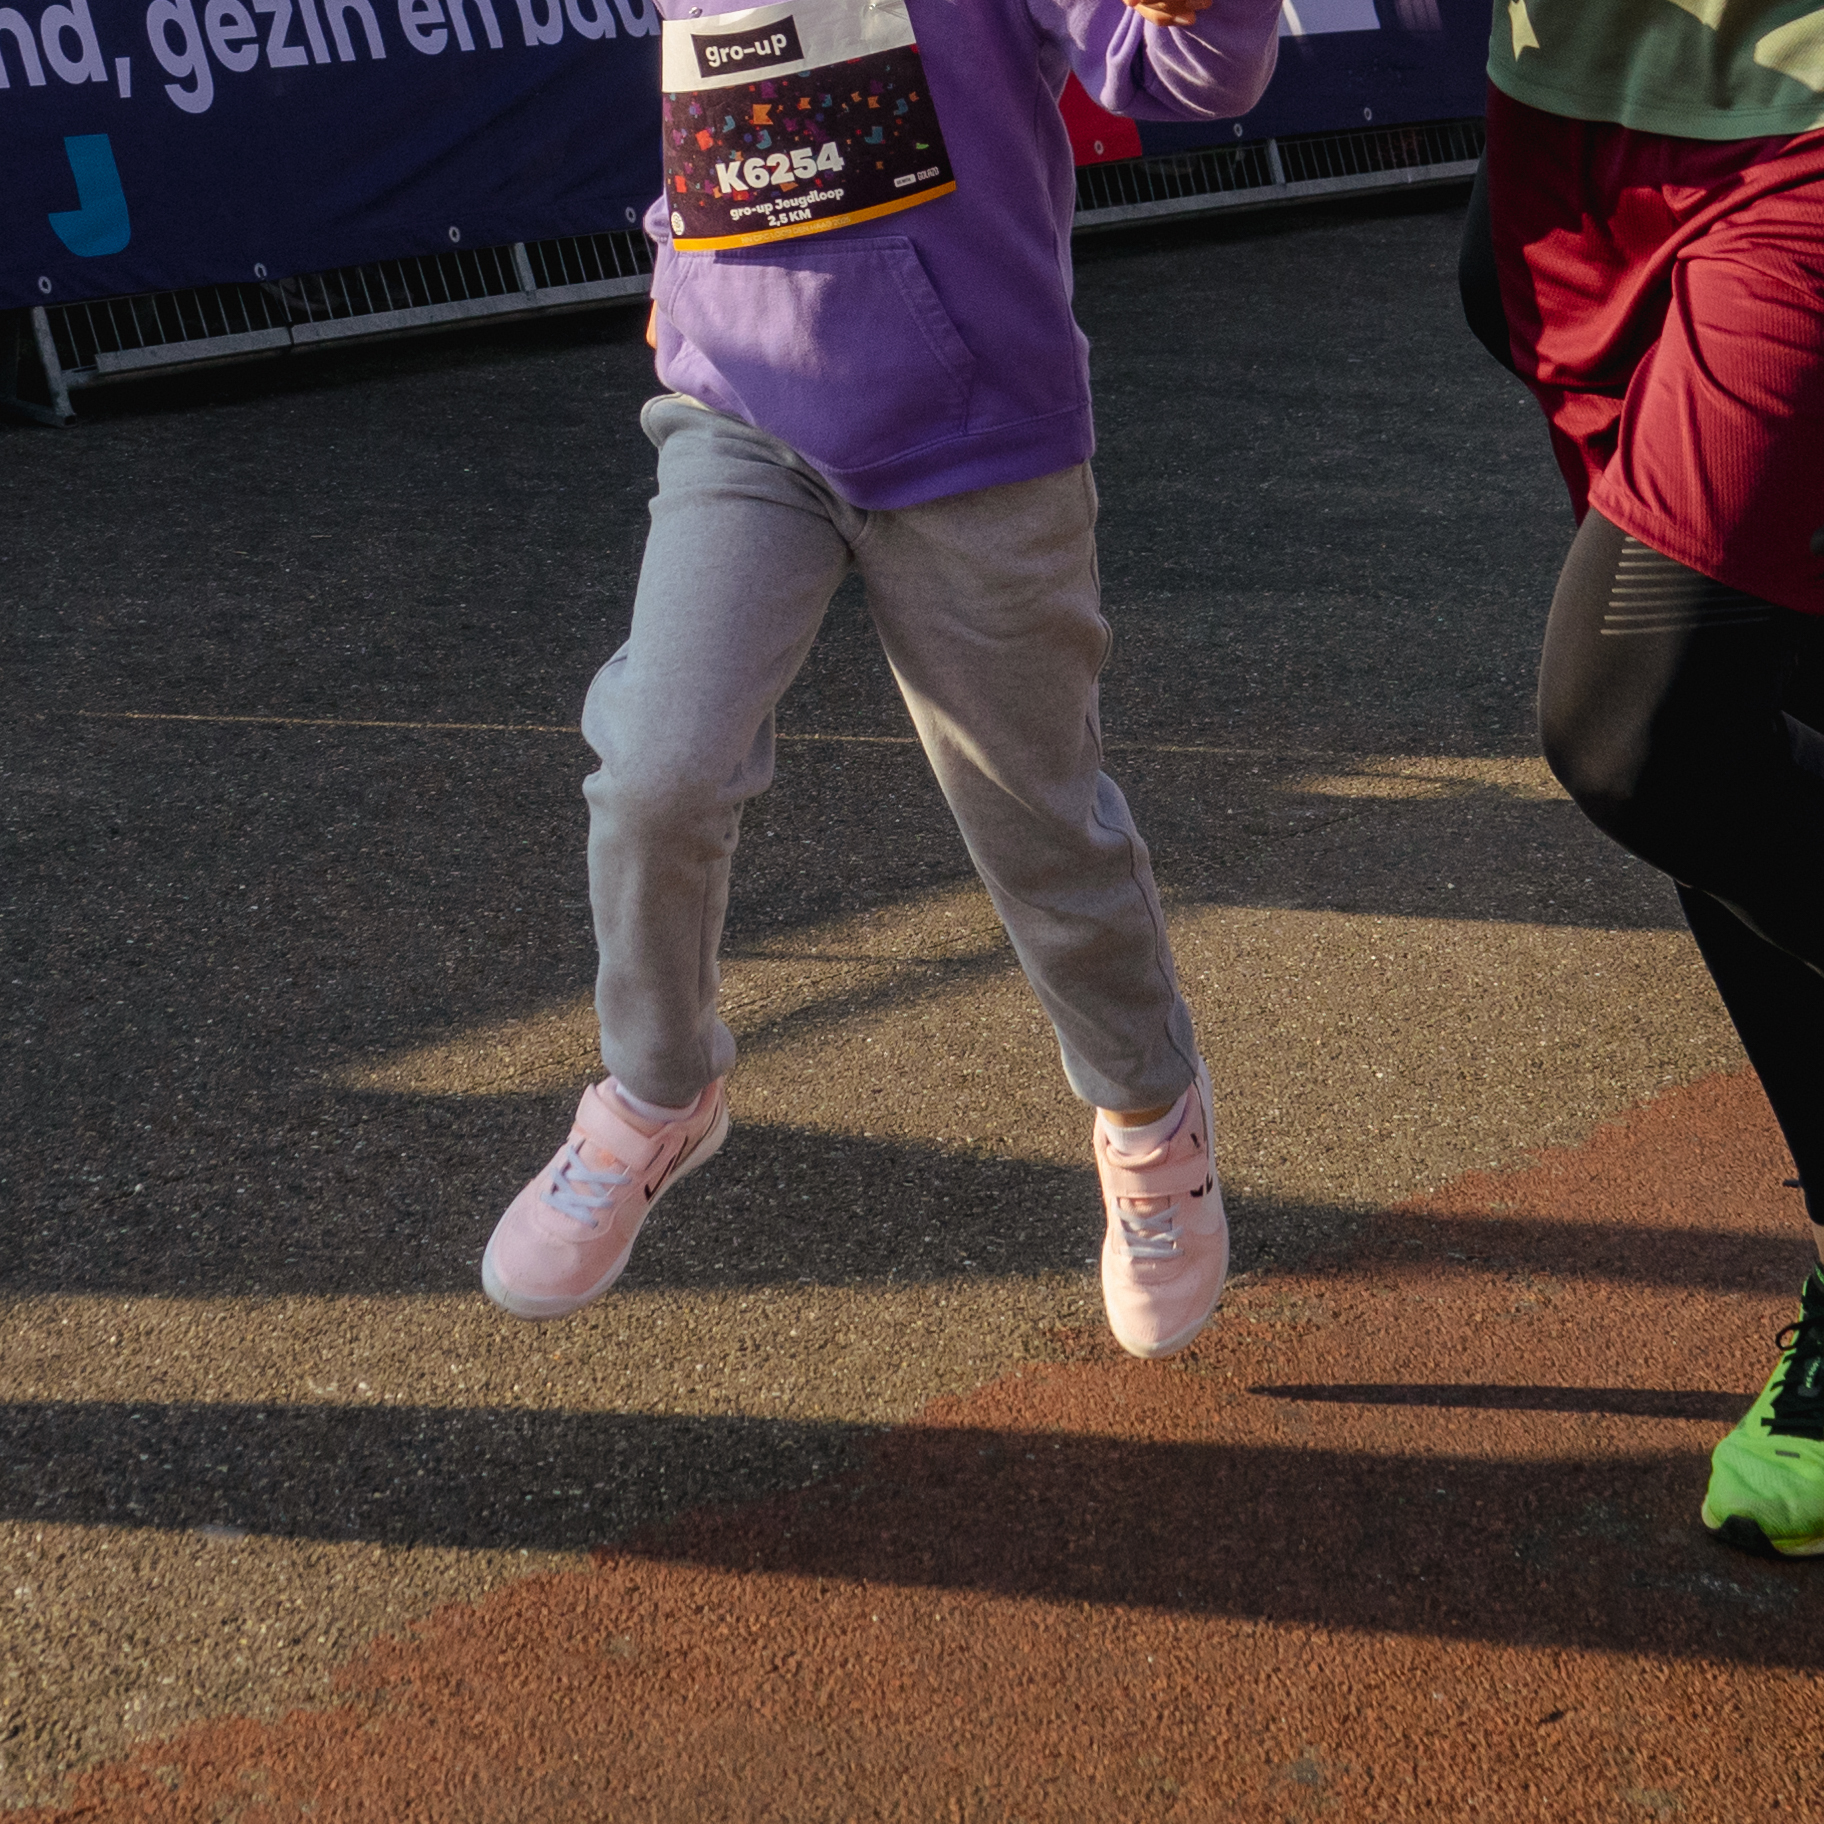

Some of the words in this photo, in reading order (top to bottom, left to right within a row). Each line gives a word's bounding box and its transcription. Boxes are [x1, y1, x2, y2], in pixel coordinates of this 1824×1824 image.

[705, 33, 788, 68] gro-up
[715, 141, 845, 194] K6254
[730, 201, 774, 221] gro-up
[774, 187, 845, 211] Jeugdloop
[767, 214, 788, 227] 2,5
[789, 208, 812, 223] KM
